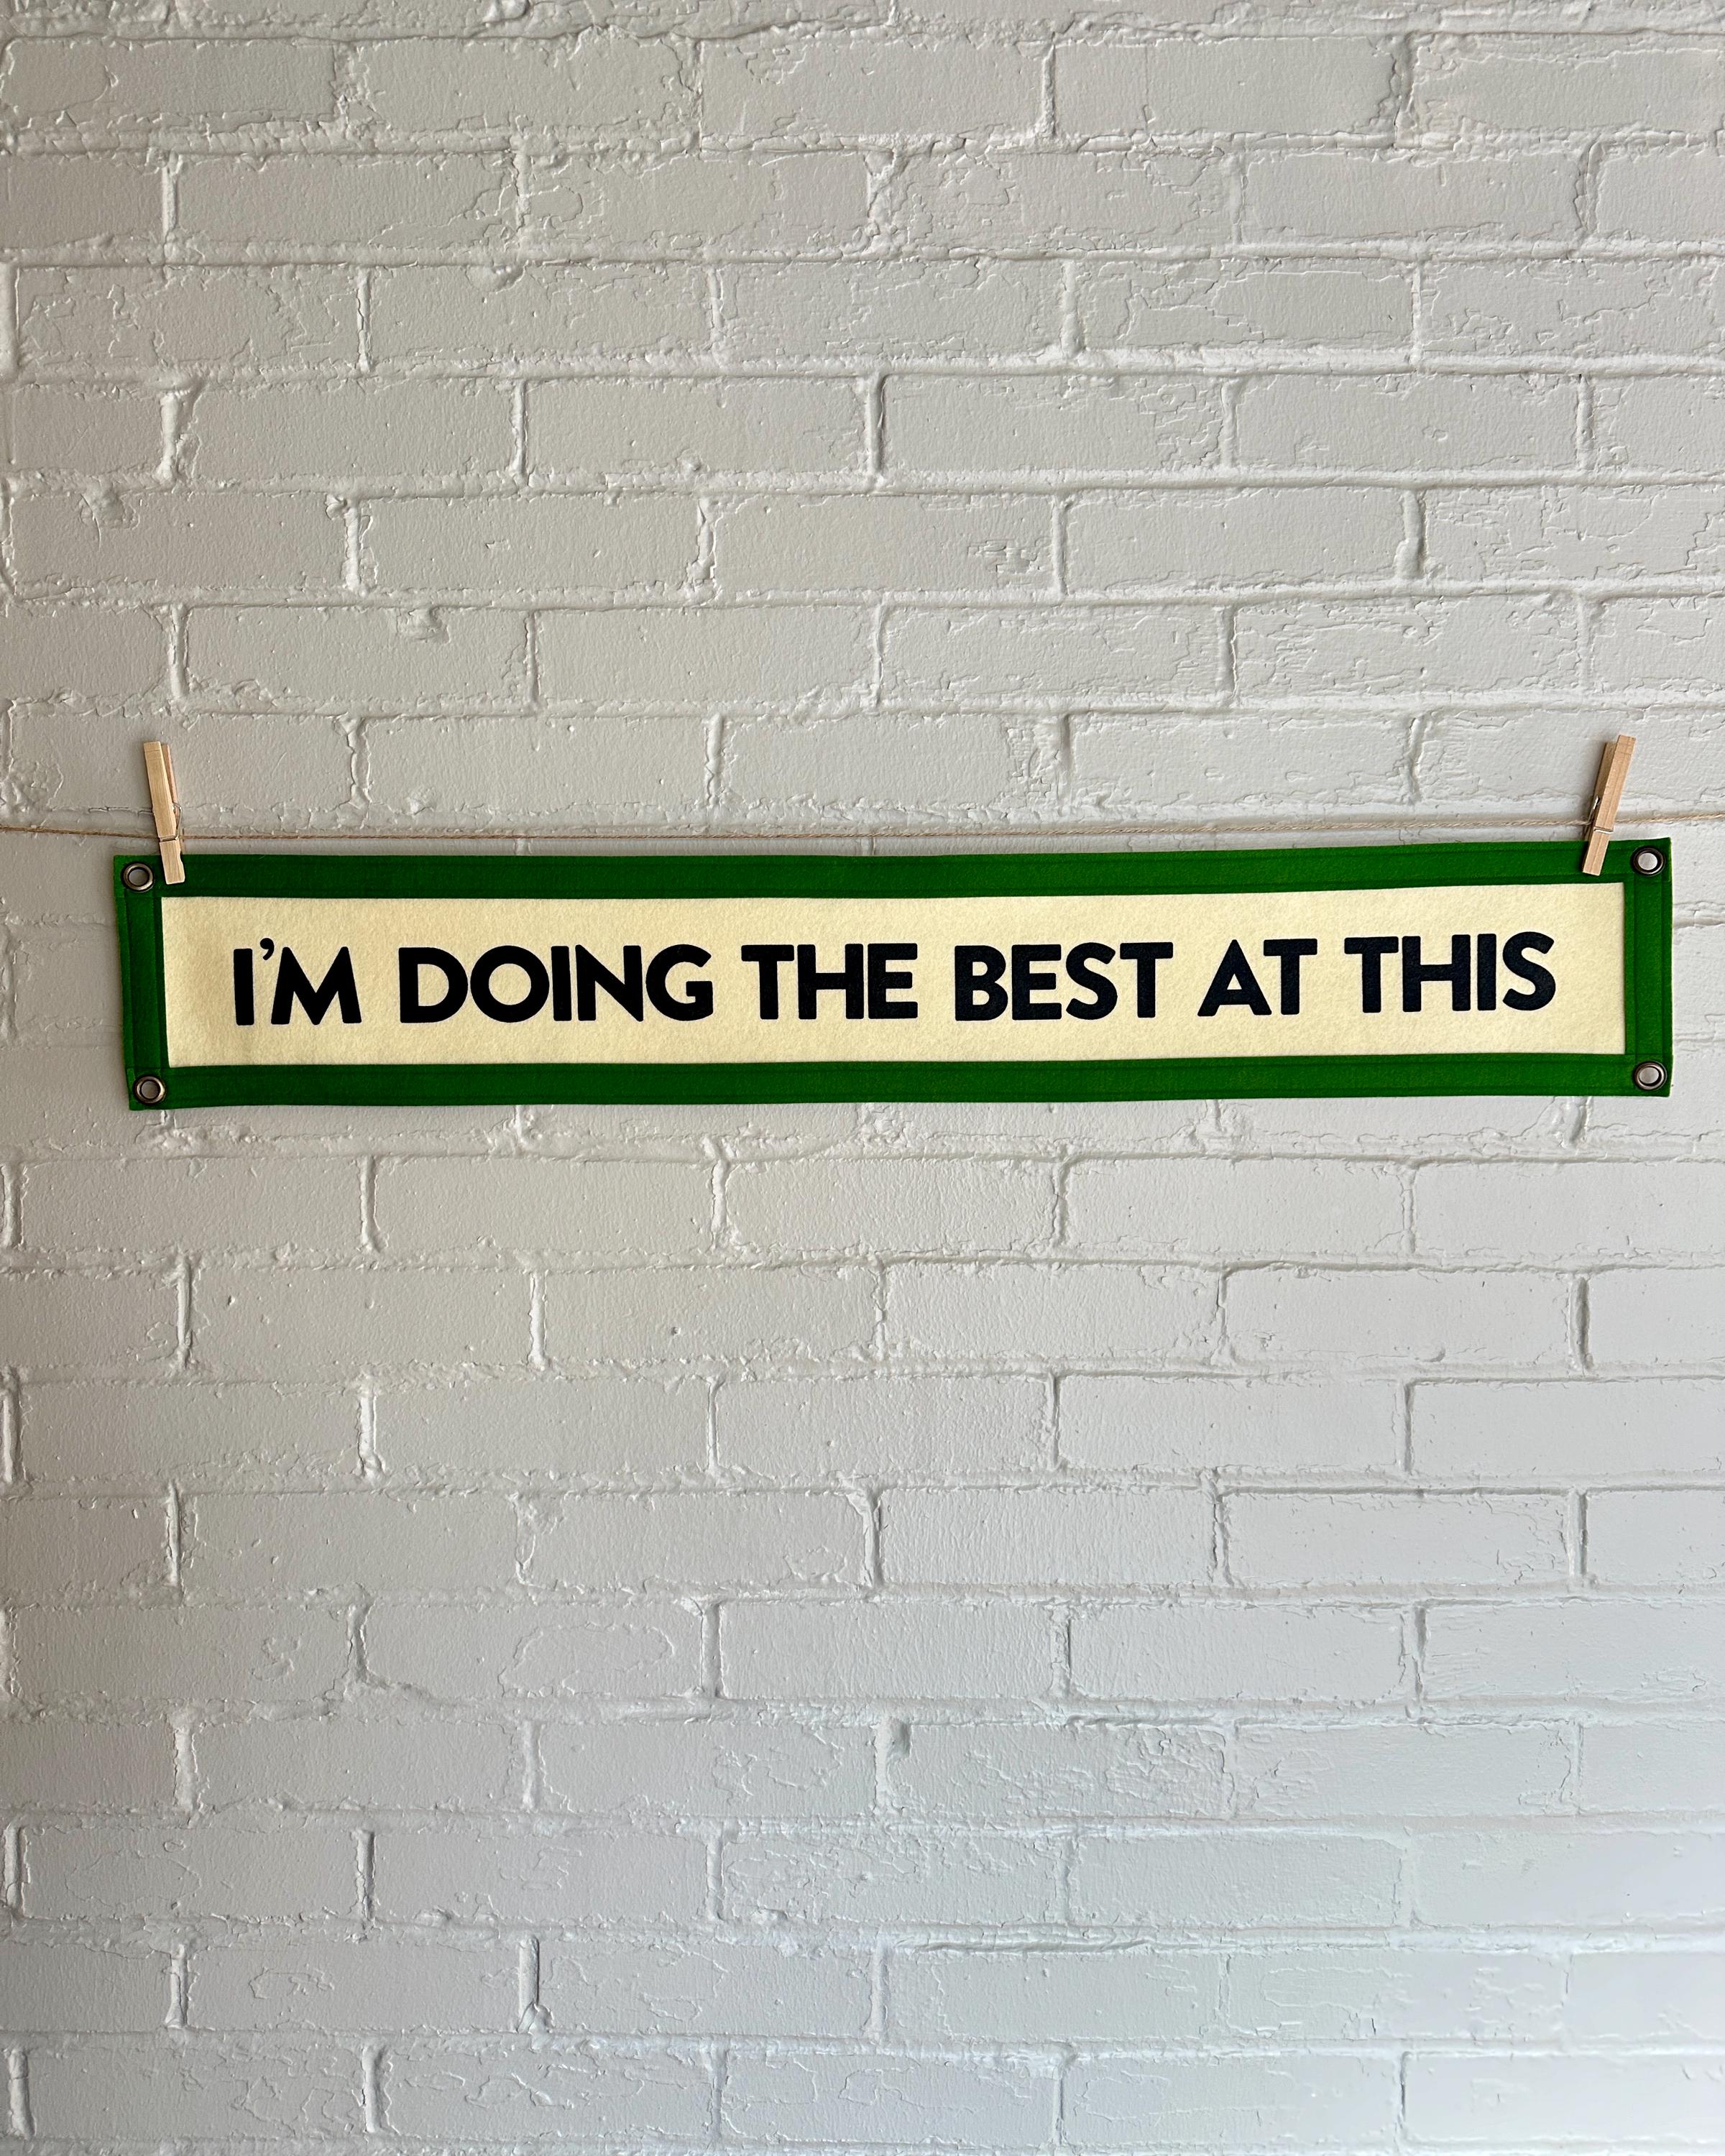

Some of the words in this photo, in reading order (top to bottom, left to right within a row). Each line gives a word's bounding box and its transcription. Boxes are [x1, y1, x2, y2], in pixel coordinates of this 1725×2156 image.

[398, 944, 714, 1024] DOING
[740, 943, 919, 1021] THE
[954, 941, 1174, 1022] BEST
[1197, 939, 1318, 1017] AT
[1343, 931, 1556, 1014] THIS
